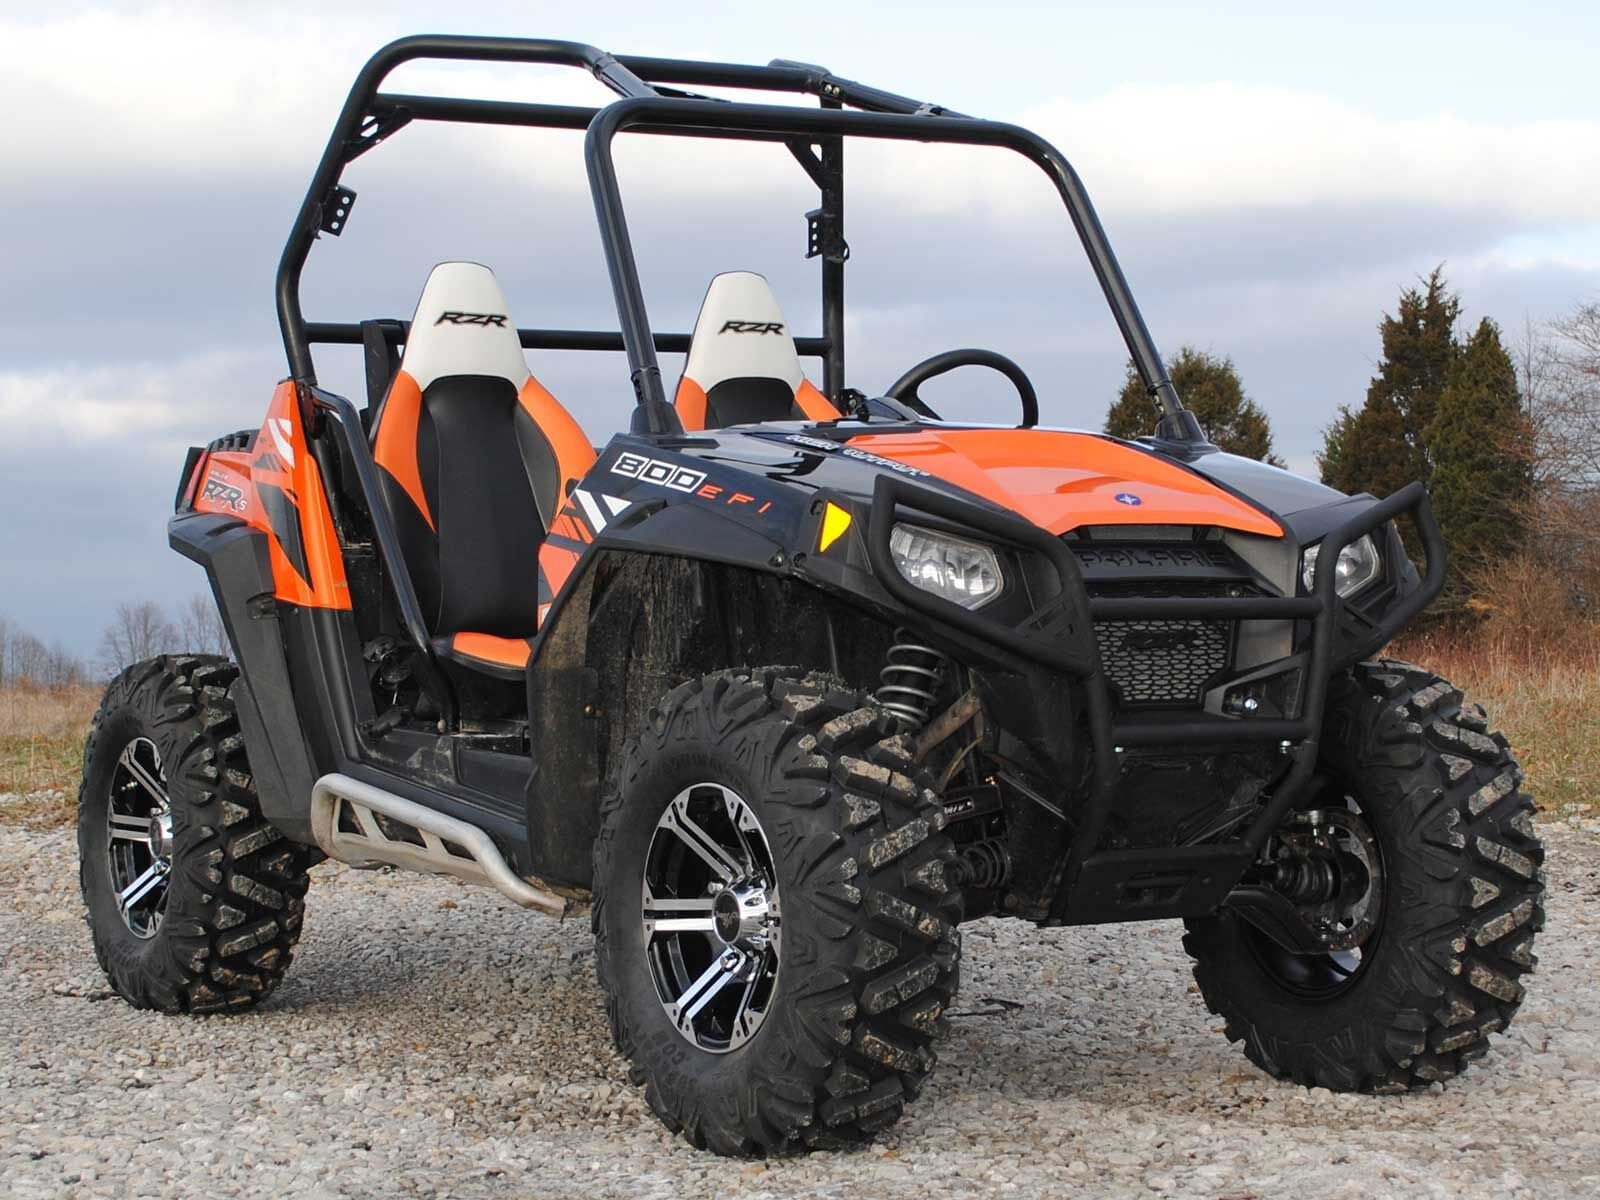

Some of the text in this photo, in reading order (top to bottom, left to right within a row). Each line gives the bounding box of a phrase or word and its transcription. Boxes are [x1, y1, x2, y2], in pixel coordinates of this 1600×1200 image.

[434, 311, 508, 328] RZR
[718, 320, 784, 335] RZR
[201, 477, 243, 512] RZR
[610, 452, 773, 514] 800 EFI
